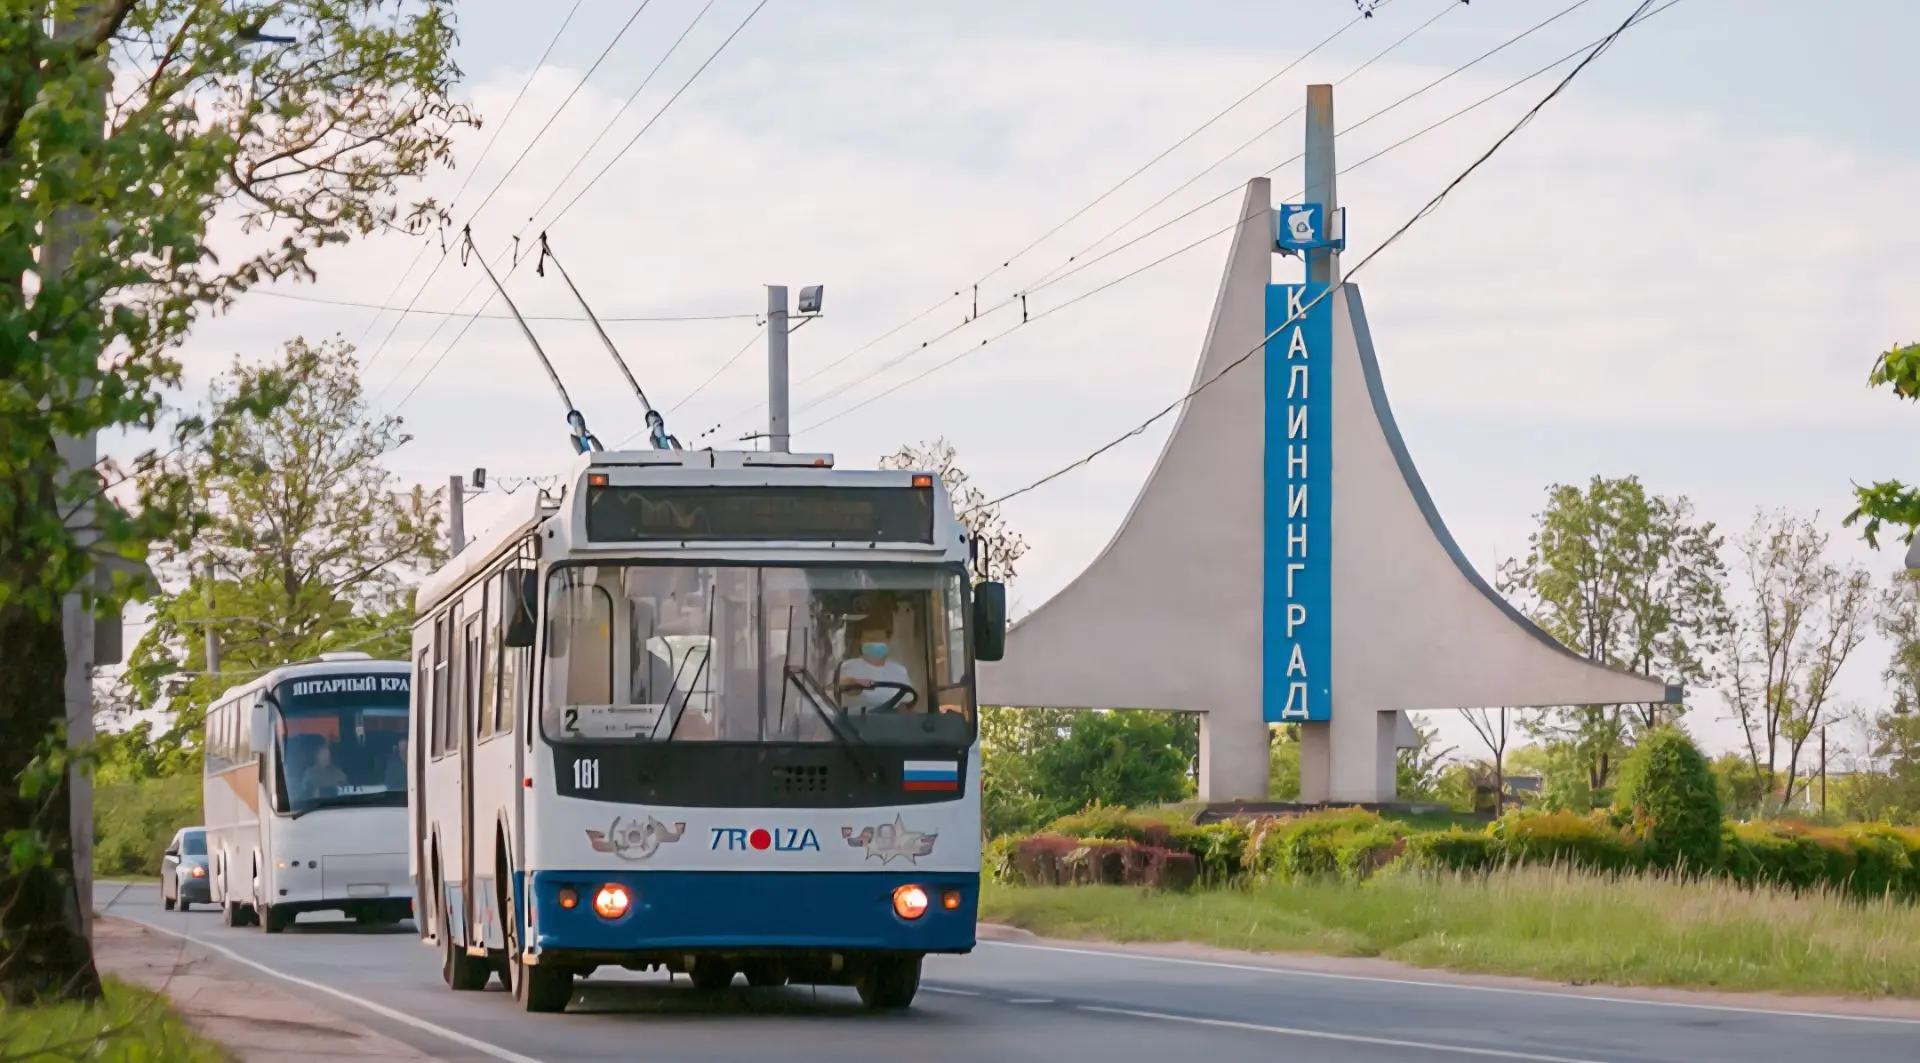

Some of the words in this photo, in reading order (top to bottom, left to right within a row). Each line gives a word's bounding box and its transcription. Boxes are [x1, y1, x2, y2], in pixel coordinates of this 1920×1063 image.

[1281, 286, 1309, 719] КАЛИНИНГРАД
[292, 676, 377, 696] ЯНТАРНЫЙ
[381, 677, 409, 692] КРА
[565, 709, 580, 732] 2
[573, 758, 599, 789] 181
[711, 828, 820, 851] TROLZA
